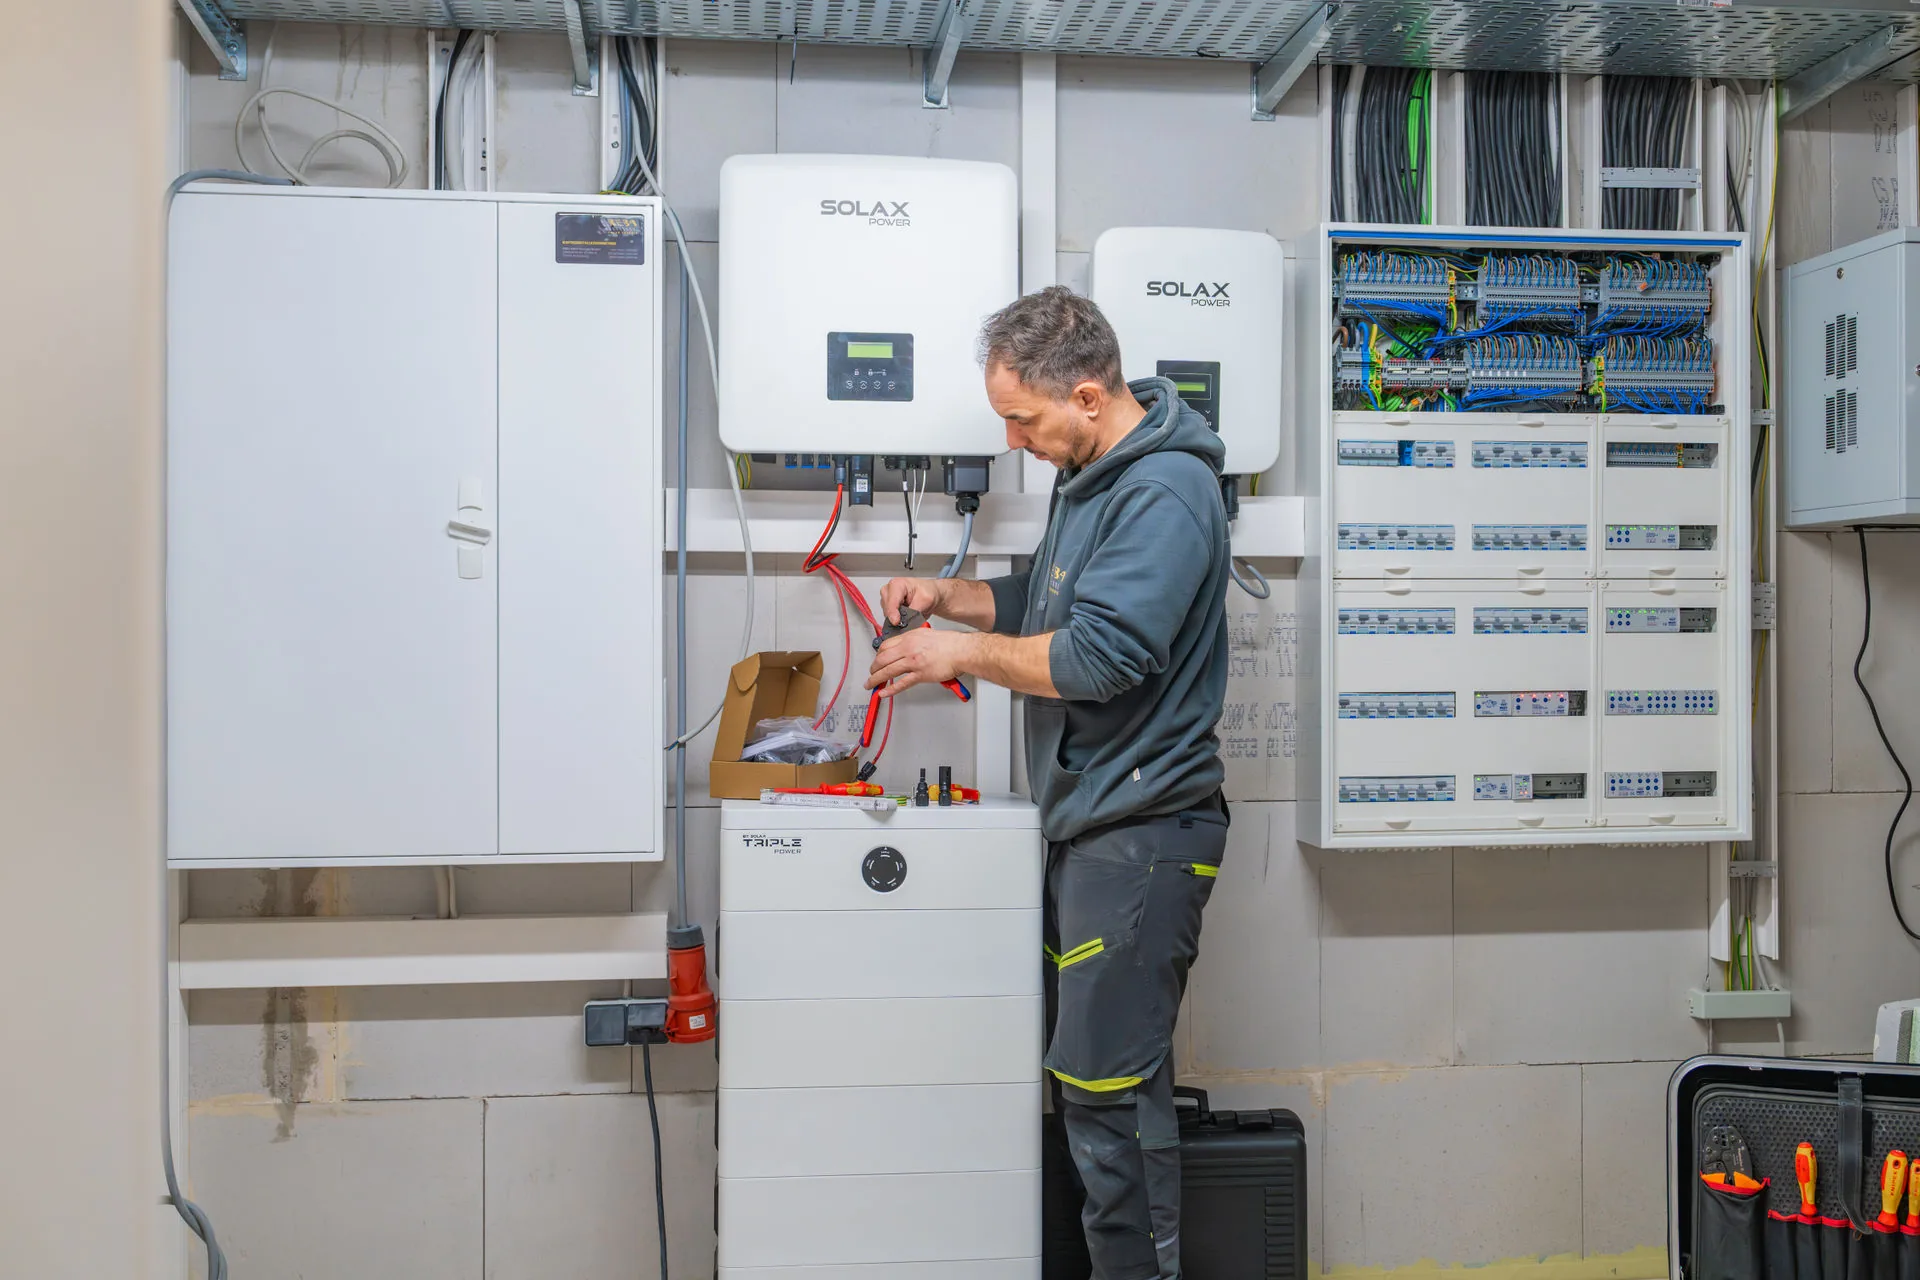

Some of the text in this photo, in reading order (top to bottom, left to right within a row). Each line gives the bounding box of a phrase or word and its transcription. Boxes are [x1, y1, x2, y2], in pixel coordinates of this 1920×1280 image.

[820, 199, 910, 218] SOLAX
[868, 218, 911, 227] POWER
[1146, 280, 1230, 298] SOLAX
[1190, 298, 1231, 307] POWER
[743, 838, 802, 847] TRIPLE
